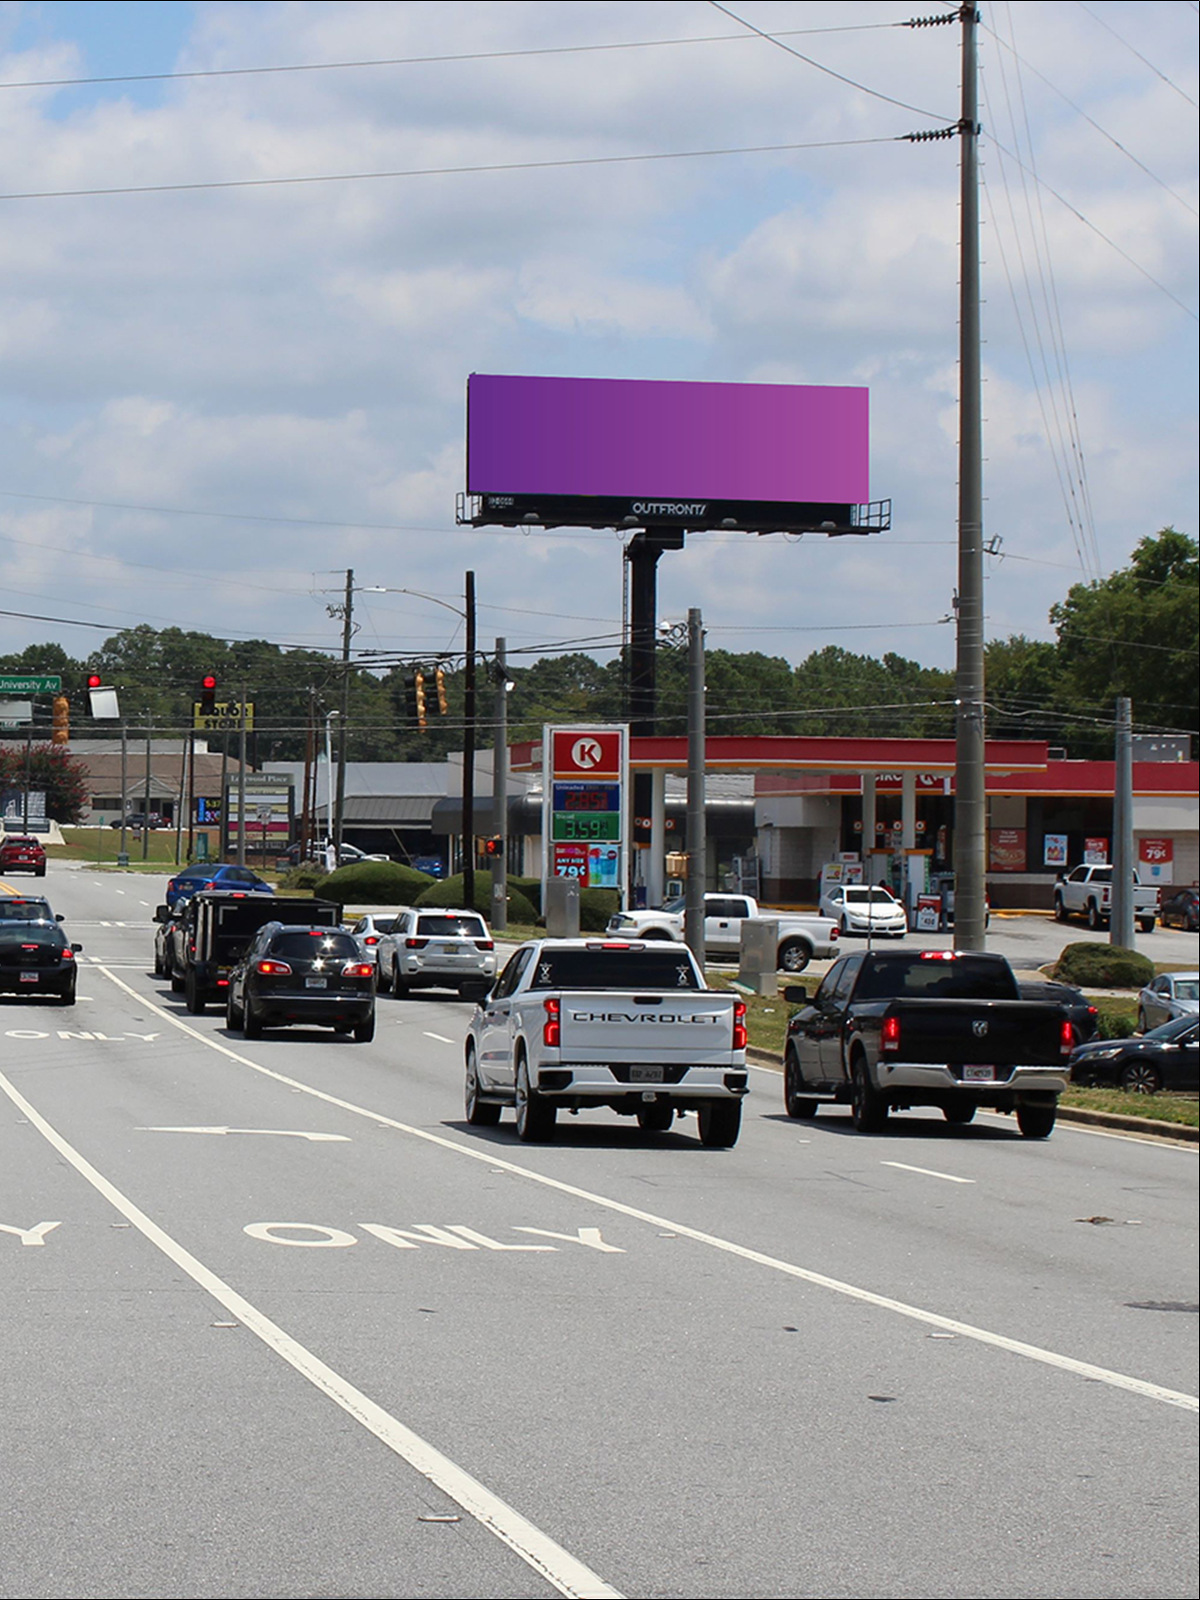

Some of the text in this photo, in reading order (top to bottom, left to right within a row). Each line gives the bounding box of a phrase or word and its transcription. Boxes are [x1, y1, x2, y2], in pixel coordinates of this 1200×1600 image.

[44, 680, 57, 689] Av
[205, 719, 245, 728] STOR
[580, 743, 600, 766] K
[231, 775, 267, 783] Lwood
[566, 820, 600, 839] 3.59
[556, 865, 586, 878] 79¢
[573, 1012, 722, 1024] CHEVROLET
[5, 1030, 160, 1042] ONLY
[243, 1222, 626, 1253] ONLY
